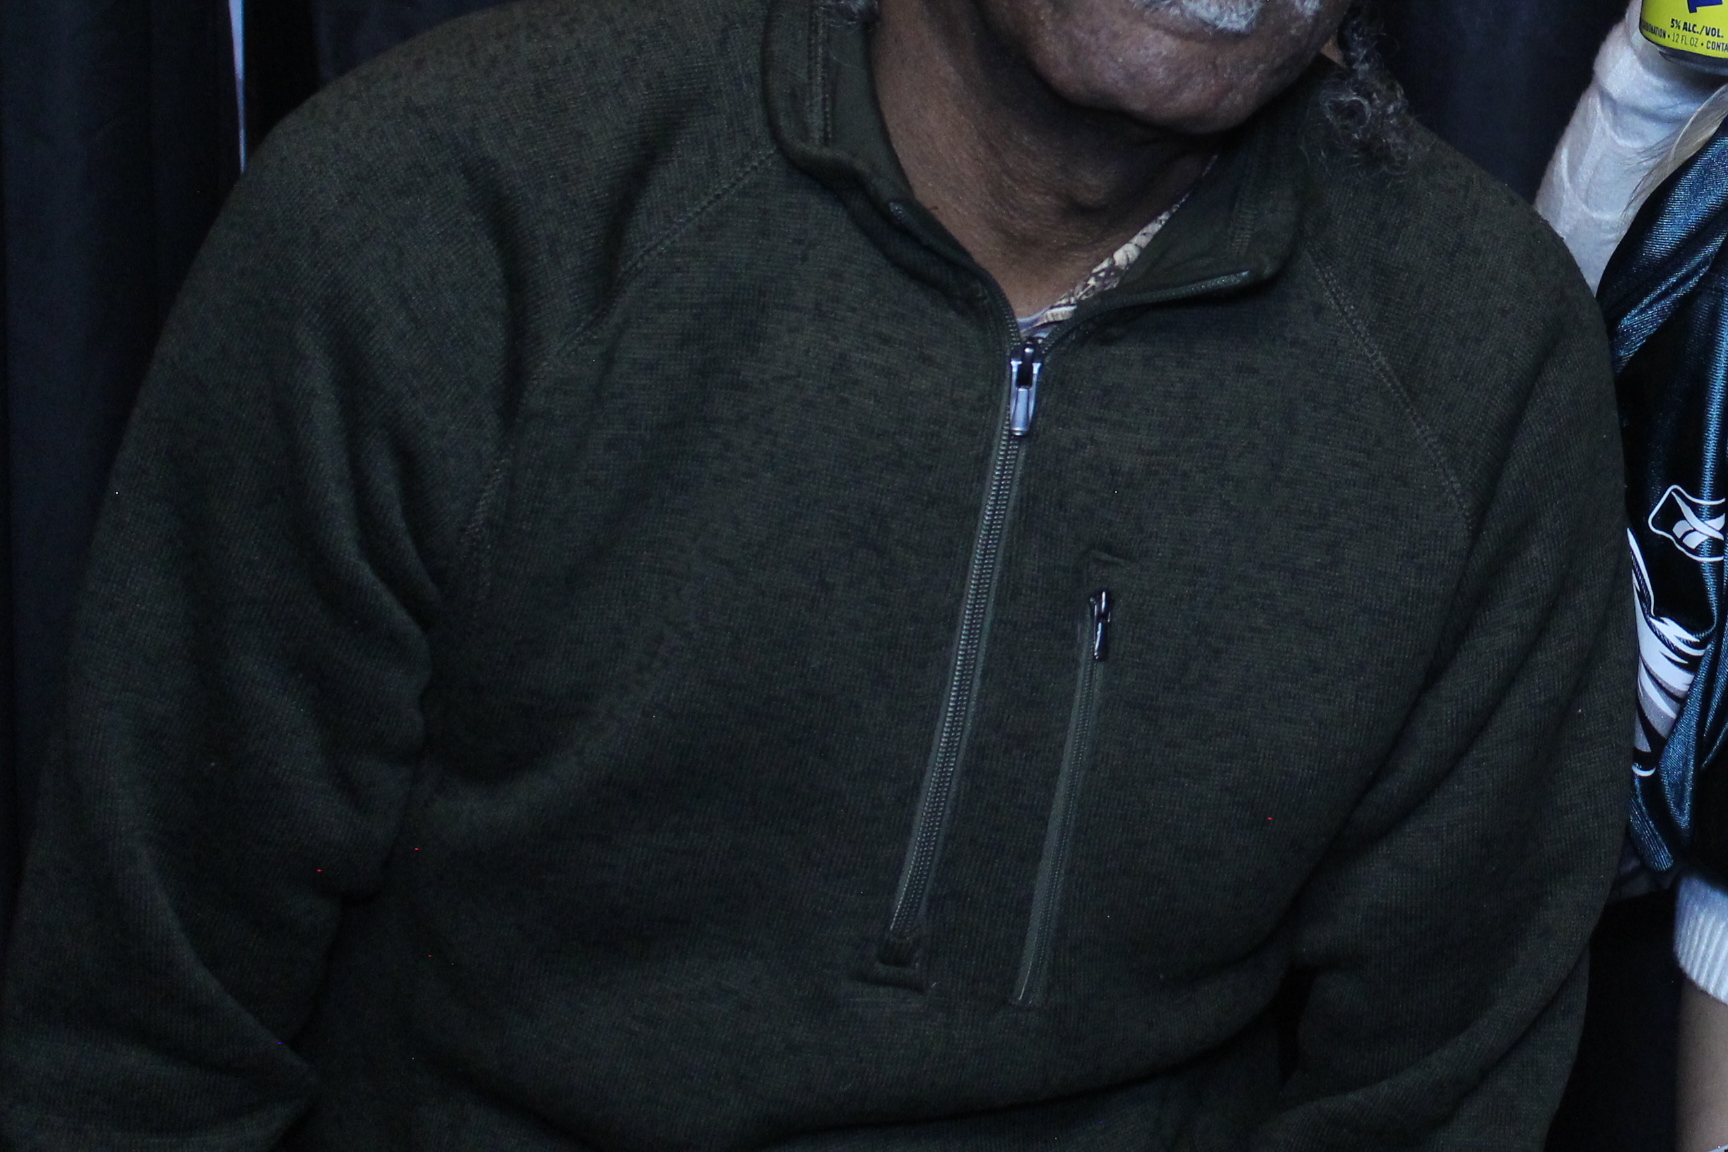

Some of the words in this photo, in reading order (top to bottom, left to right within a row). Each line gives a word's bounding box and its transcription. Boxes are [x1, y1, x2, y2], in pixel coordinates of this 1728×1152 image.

[1670, 18, 1681, 30] 5%
[1682, 21, 1724, 39] ALC./VOL.
[1672, 32, 1680, 44] 12
[1680, 35, 1688, 46] FL
[1689, 37, 1699, 48] OZ
